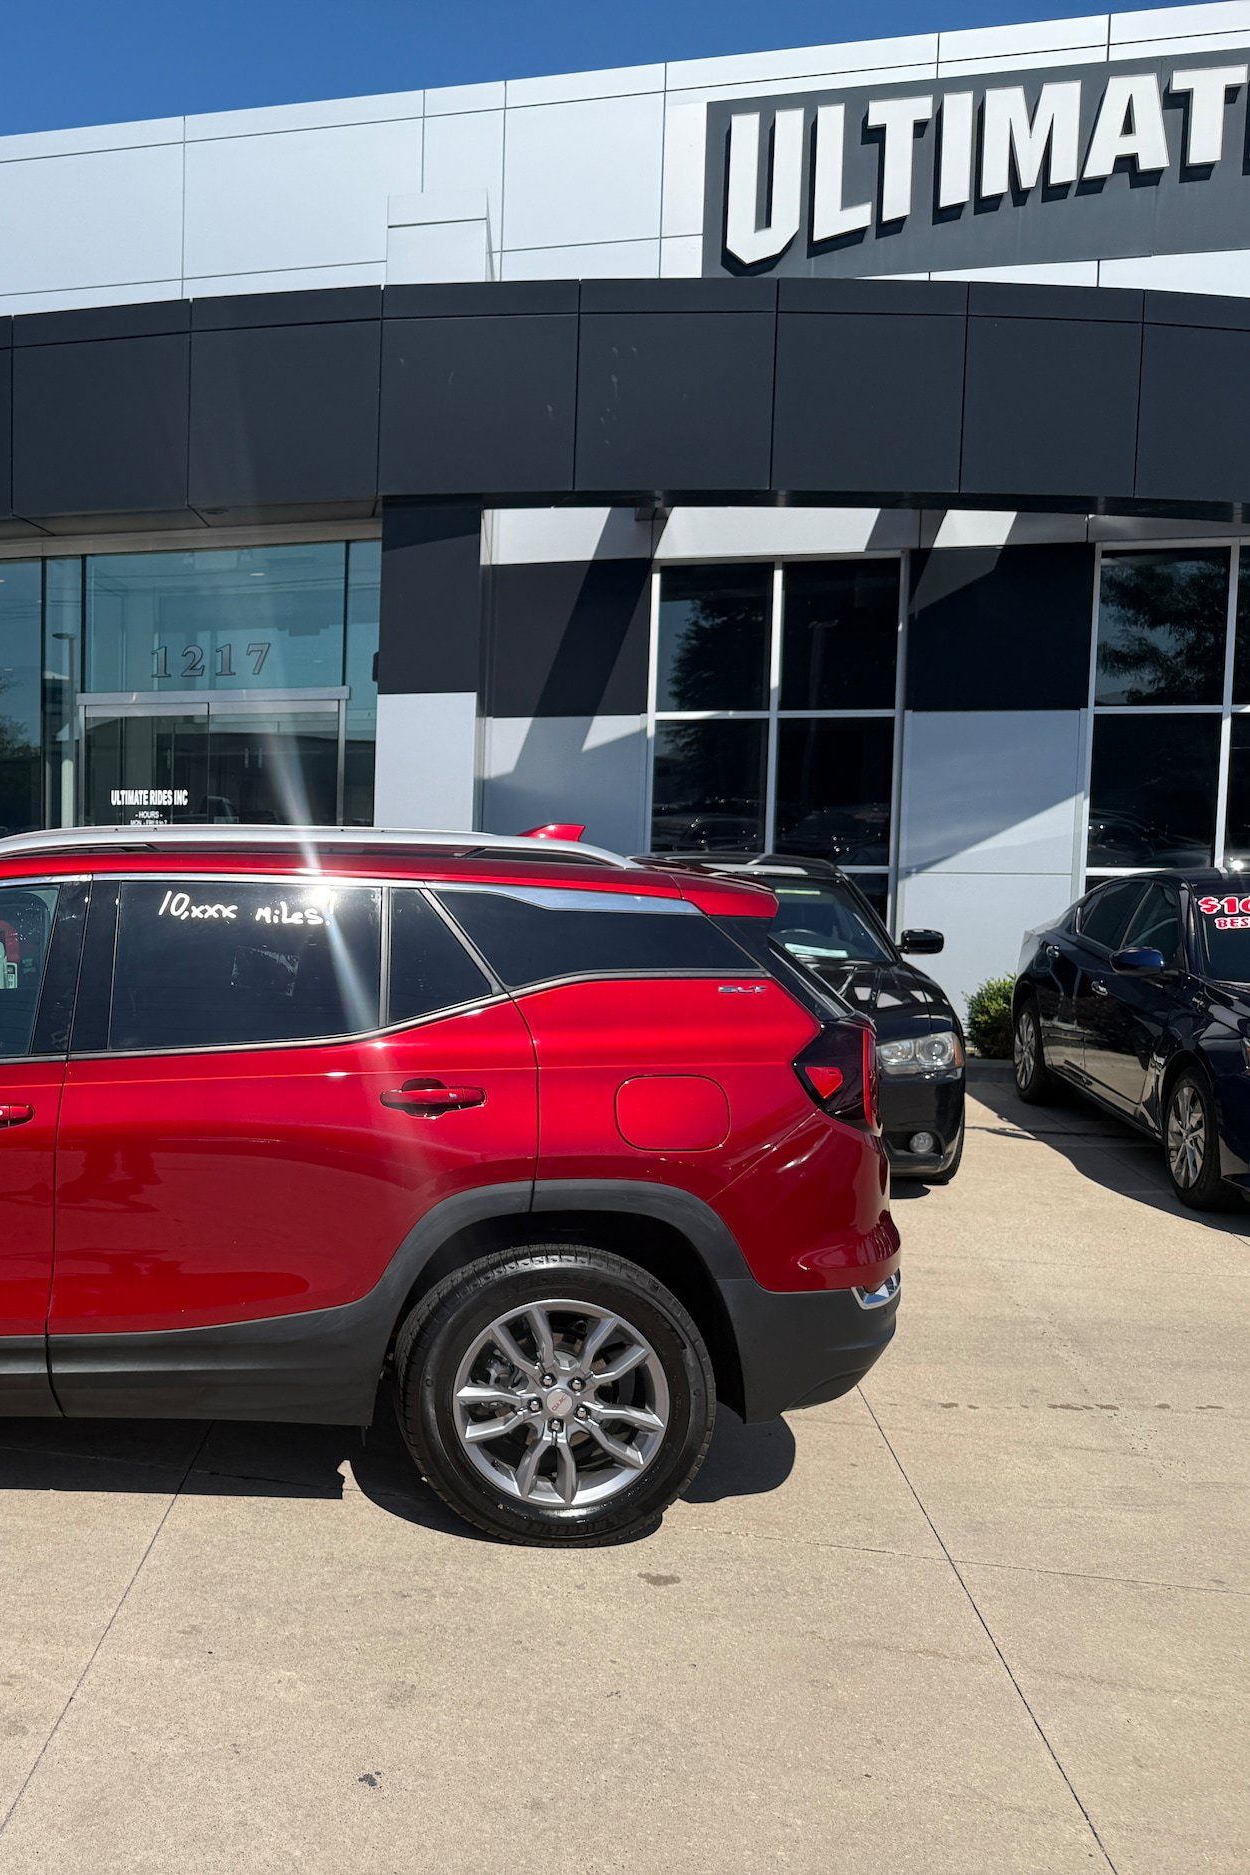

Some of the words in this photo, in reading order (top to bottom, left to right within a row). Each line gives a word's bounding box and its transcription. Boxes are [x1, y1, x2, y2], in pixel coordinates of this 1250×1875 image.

[725, 64, 1250, 265] ULTIMAT
[150, 643, 271, 678] 1217
[111, 789, 149, 806] ULTIMATE
[150, 789, 173, 806] RIDES
[174, 789, 188, 806] INC
